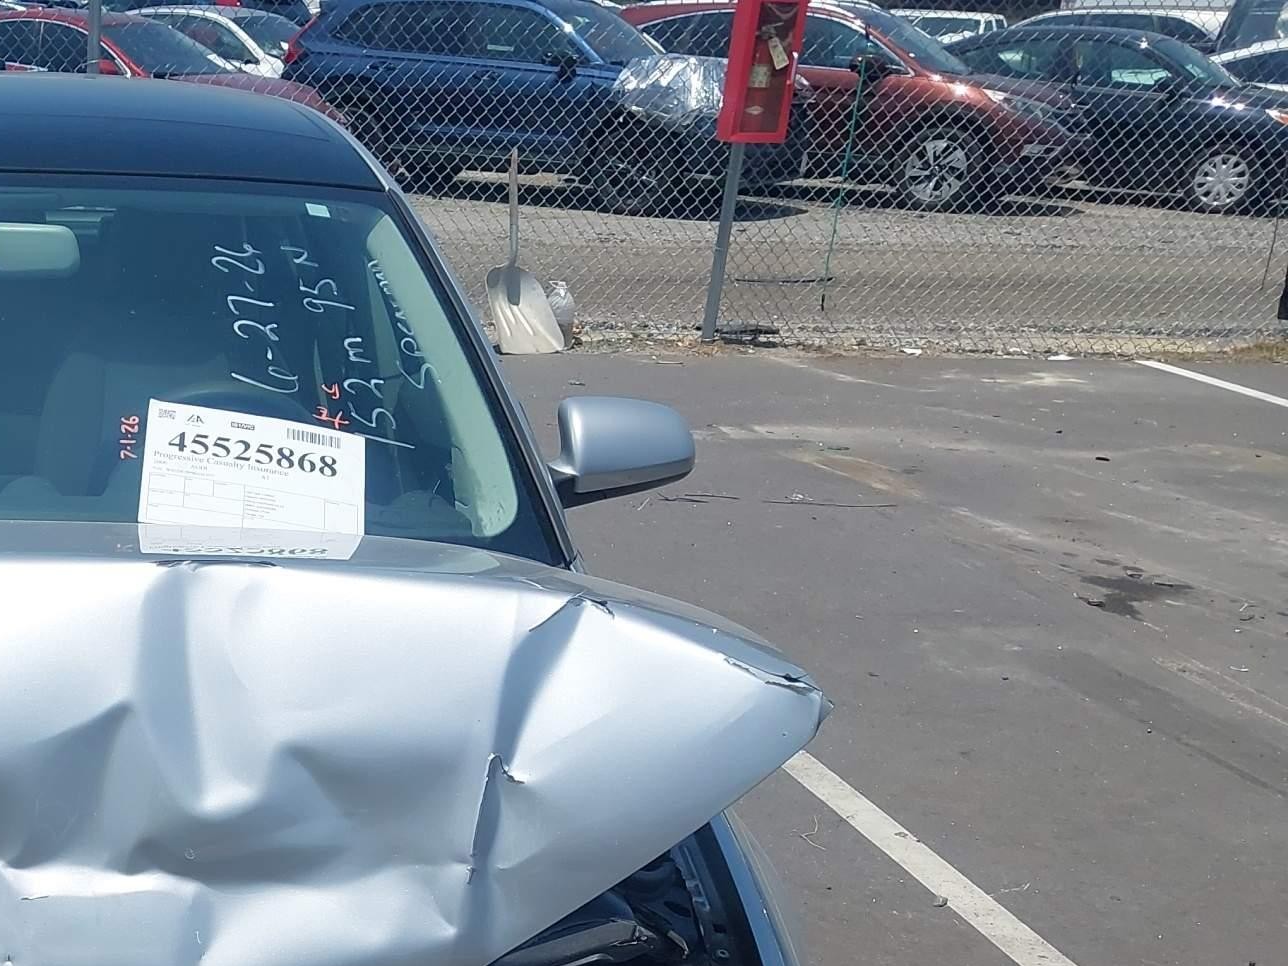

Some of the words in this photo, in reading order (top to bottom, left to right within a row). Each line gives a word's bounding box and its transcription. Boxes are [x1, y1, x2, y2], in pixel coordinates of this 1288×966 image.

[211, 242, 299, 394] 6-27-26
[153, 449, 204, 463] Progressive
[206, 458, 244, 471] Casualty
[247, 461, 289, 477] Insurance
[168, 431, 339, 477] 45525868
